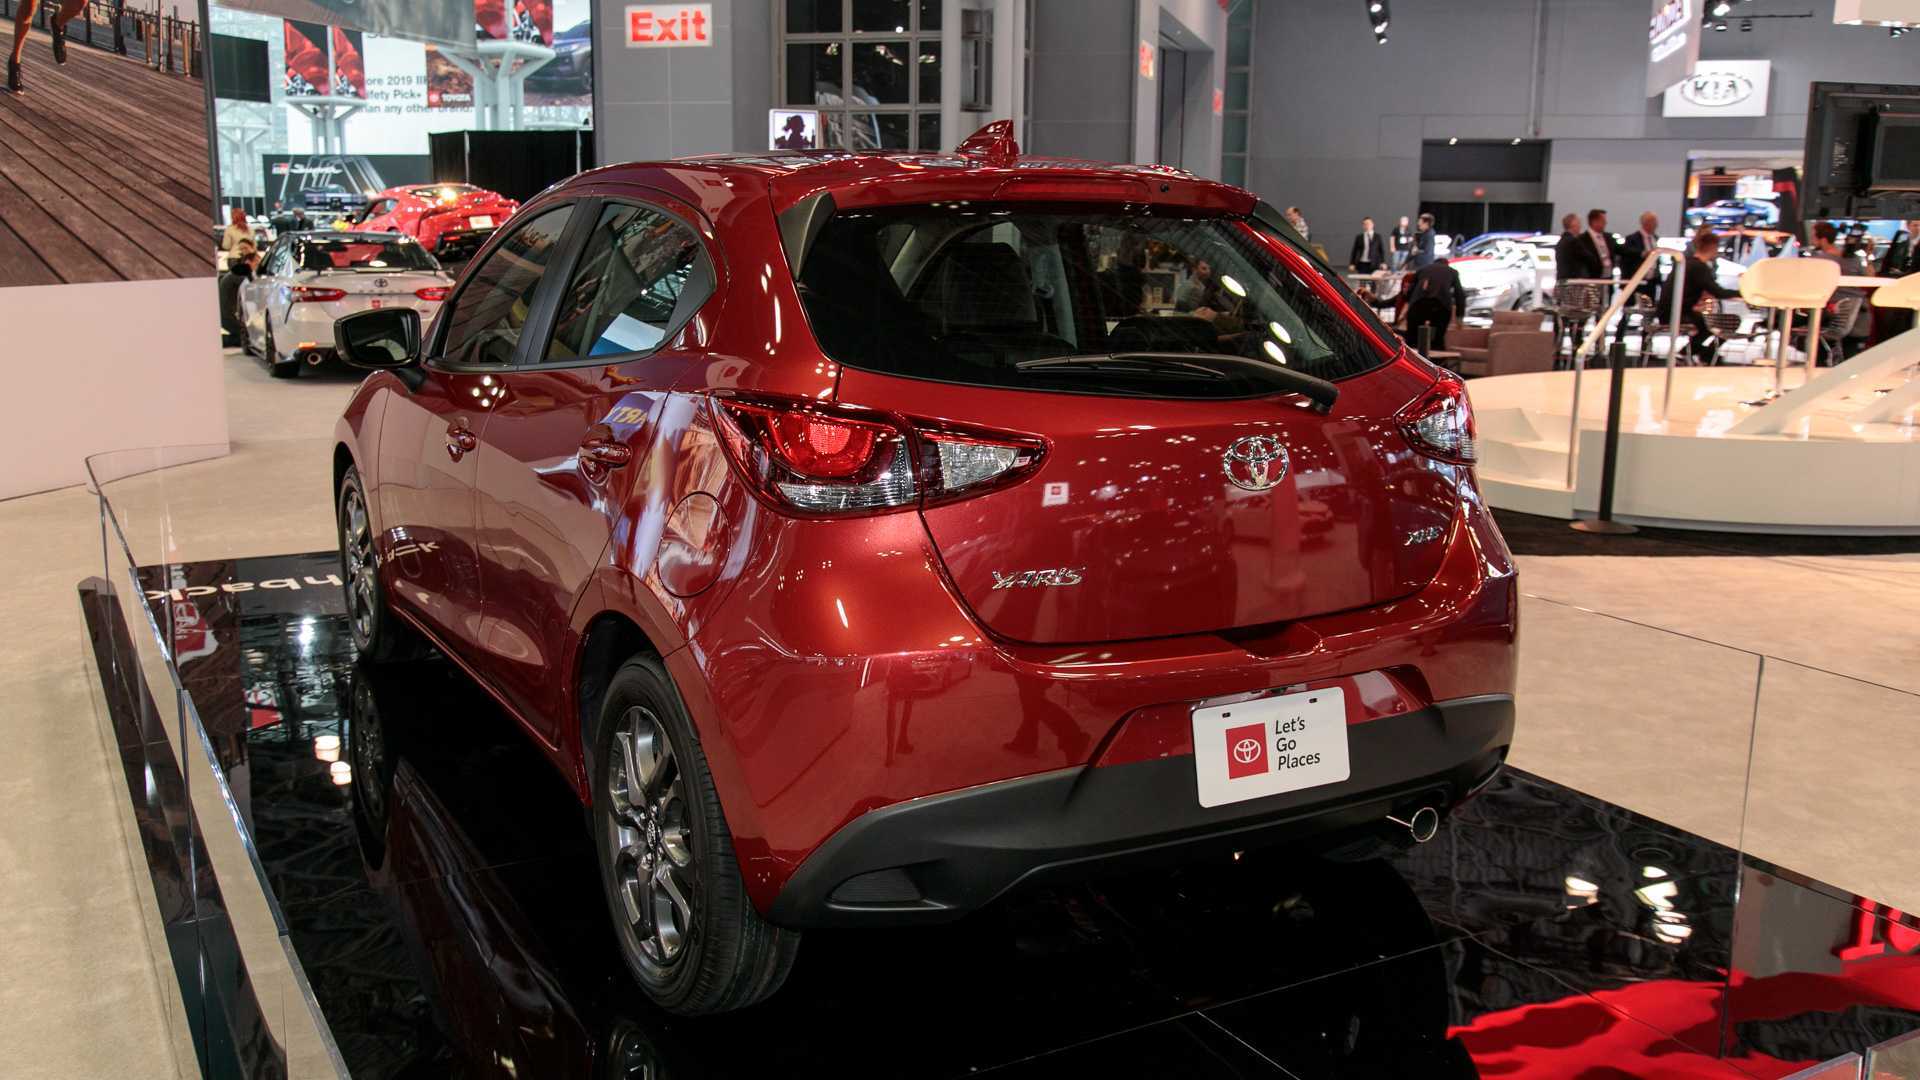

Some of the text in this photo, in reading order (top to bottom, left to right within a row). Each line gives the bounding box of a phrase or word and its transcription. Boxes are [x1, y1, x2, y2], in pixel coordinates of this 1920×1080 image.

[630, 11, 707, 42] Exit
[387, 76, 413, 85] 2019
[441, 94, 472, 102] TOYOTA
[384, 106, 402, 114] any
[992, 567, 1086, 590] YARIS
[1275, 715, 1306, 735] Let's
[1276, 736, 1297, 753] Go
[1277, 749, 1322, 771] Places
